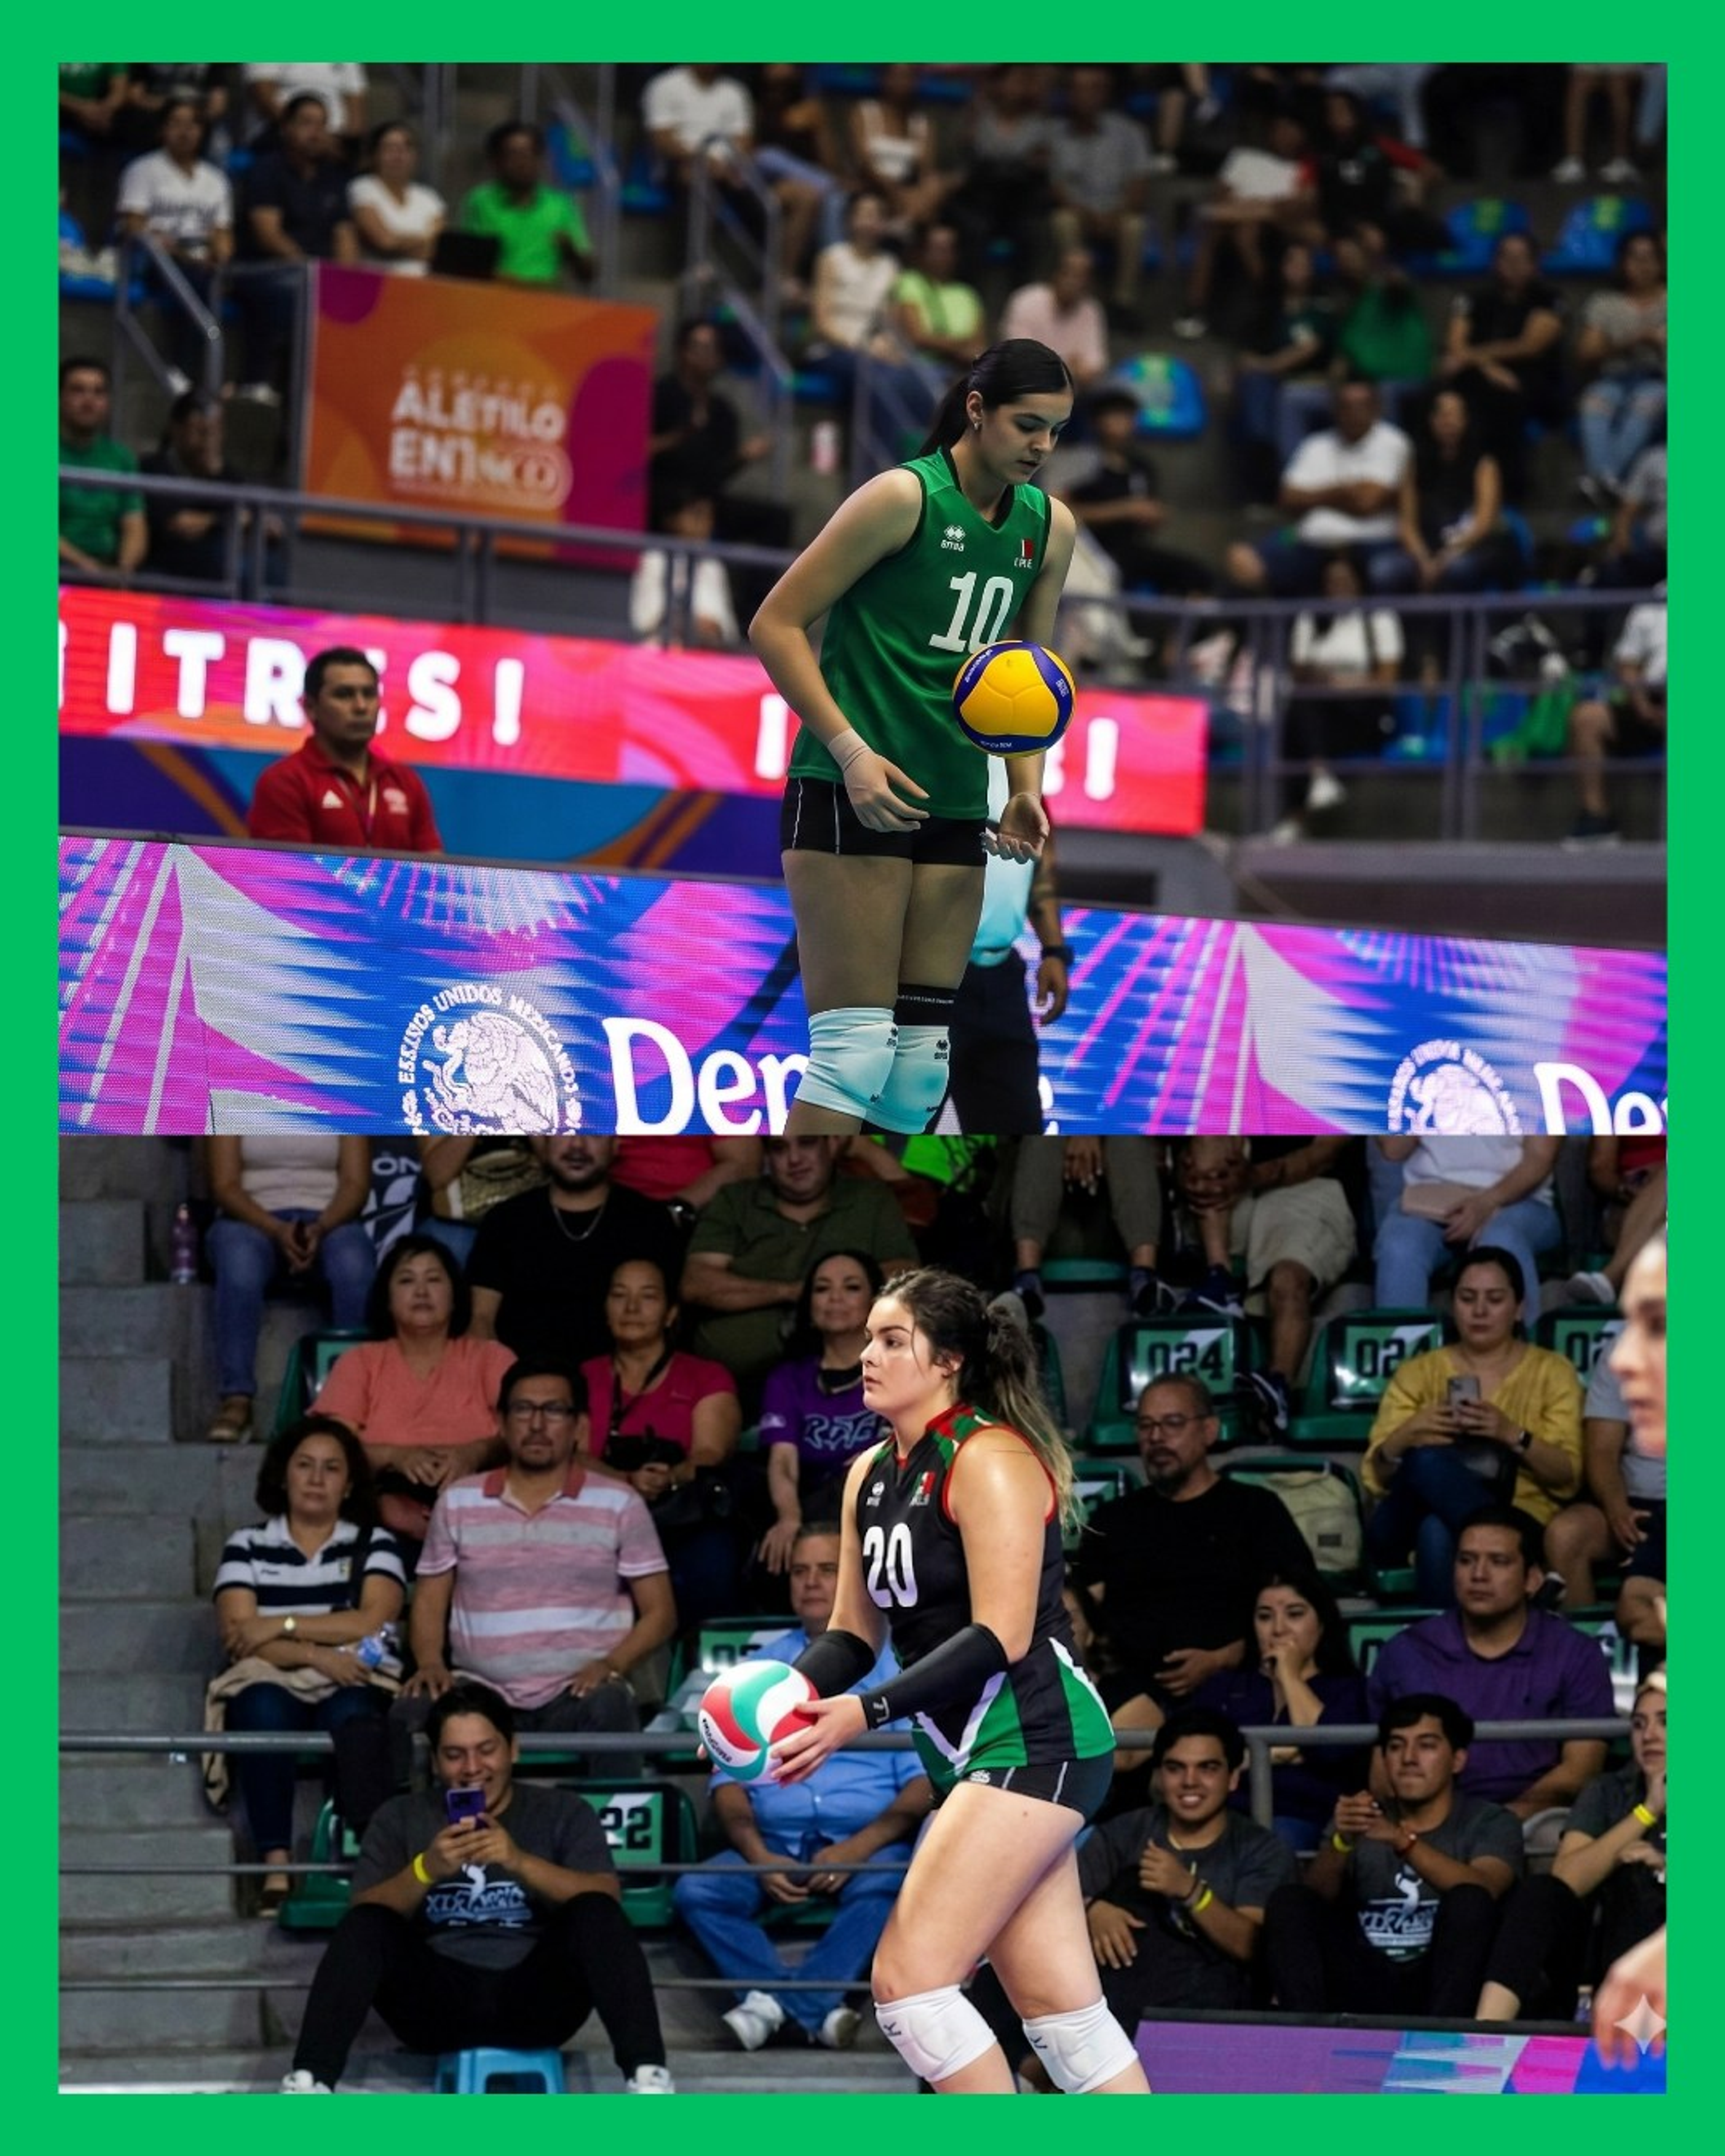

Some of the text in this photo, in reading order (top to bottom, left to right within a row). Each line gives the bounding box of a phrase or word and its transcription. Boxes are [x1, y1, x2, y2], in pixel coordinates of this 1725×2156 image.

[929, 571, 1013, 654] 10
[58, 618, 525, 746] ITRS!
[433, 985, 503, 1012] UNIDOS
[1534, 1062, 1668, 1135] De
[1149, 1339, 1225, 1380] 024
[862, 1522, 918, 1607] 20
